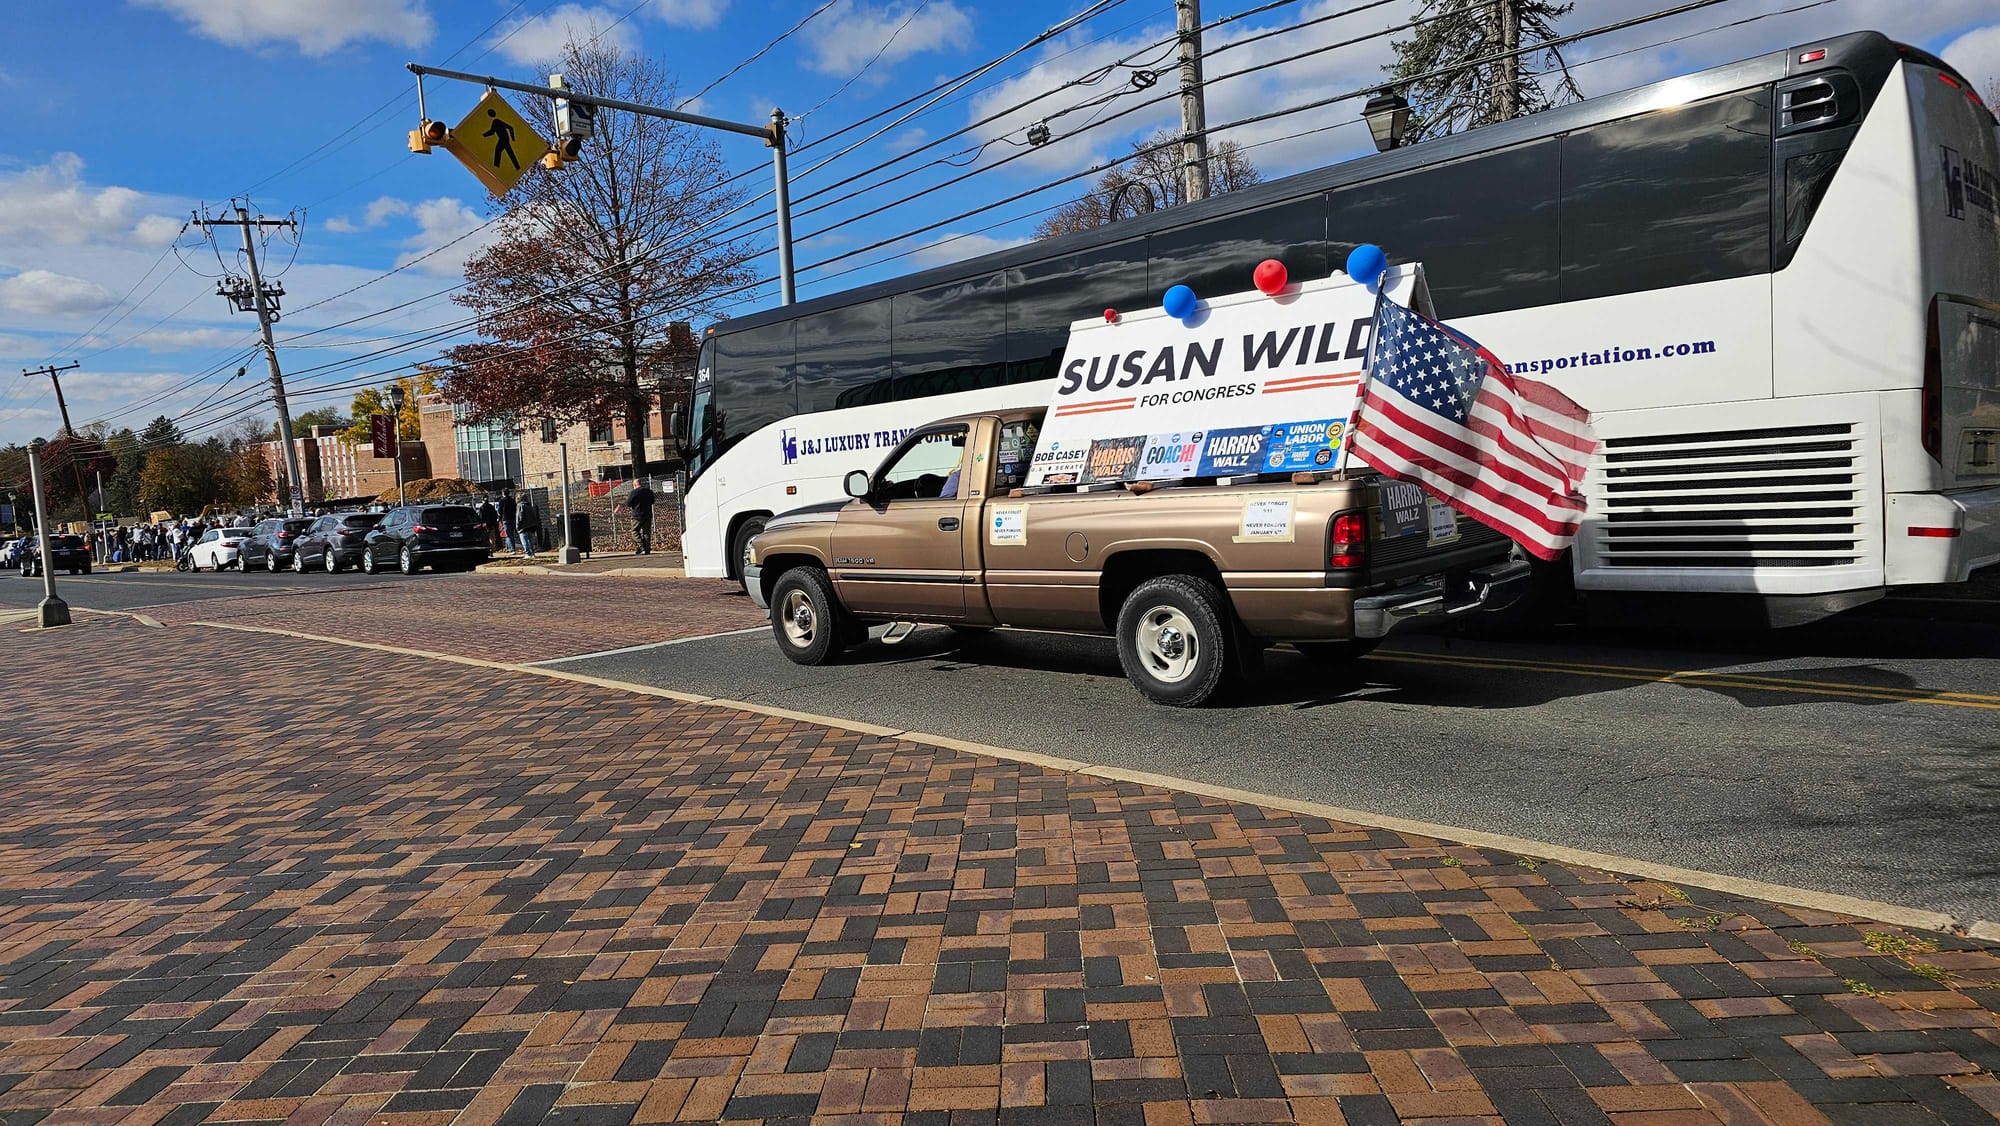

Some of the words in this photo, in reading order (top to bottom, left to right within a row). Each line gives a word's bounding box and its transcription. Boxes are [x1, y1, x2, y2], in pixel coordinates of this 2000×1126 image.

[1058, 338, 1224, 395] SUSAN
[1244, 317, 1373, 372] WILD
[1504, 340, 1716, 375] ansportation.com
[697, 367, 710, 383] 364
[1140, 393, 1169, 408] FOR
[1172, 383, 1256, 404] CONGRESS
[1289, 423, 1326, 435] UNION
[800, 440, 822, 456] J&J
[824, 434, 871, 453] LUXURY
[1206, 434, 1263, 457] HARRIS
[1284, 434, 1324, 445] LABOR
[1034, 451, 1054, 462] BOB
[1056, 449, 1087, 461] CASEY
[1090, 447, 1136, 467] HARRIS
[1146, 443, 1197, 465] COACH!
[1213, 455, 1250, 468] WALZ
[1093, 464, 1124, 477] WALZ
[1386, 484, 1423, 511] HARRIS
[1395, 508, 1420, 524] WALZ
